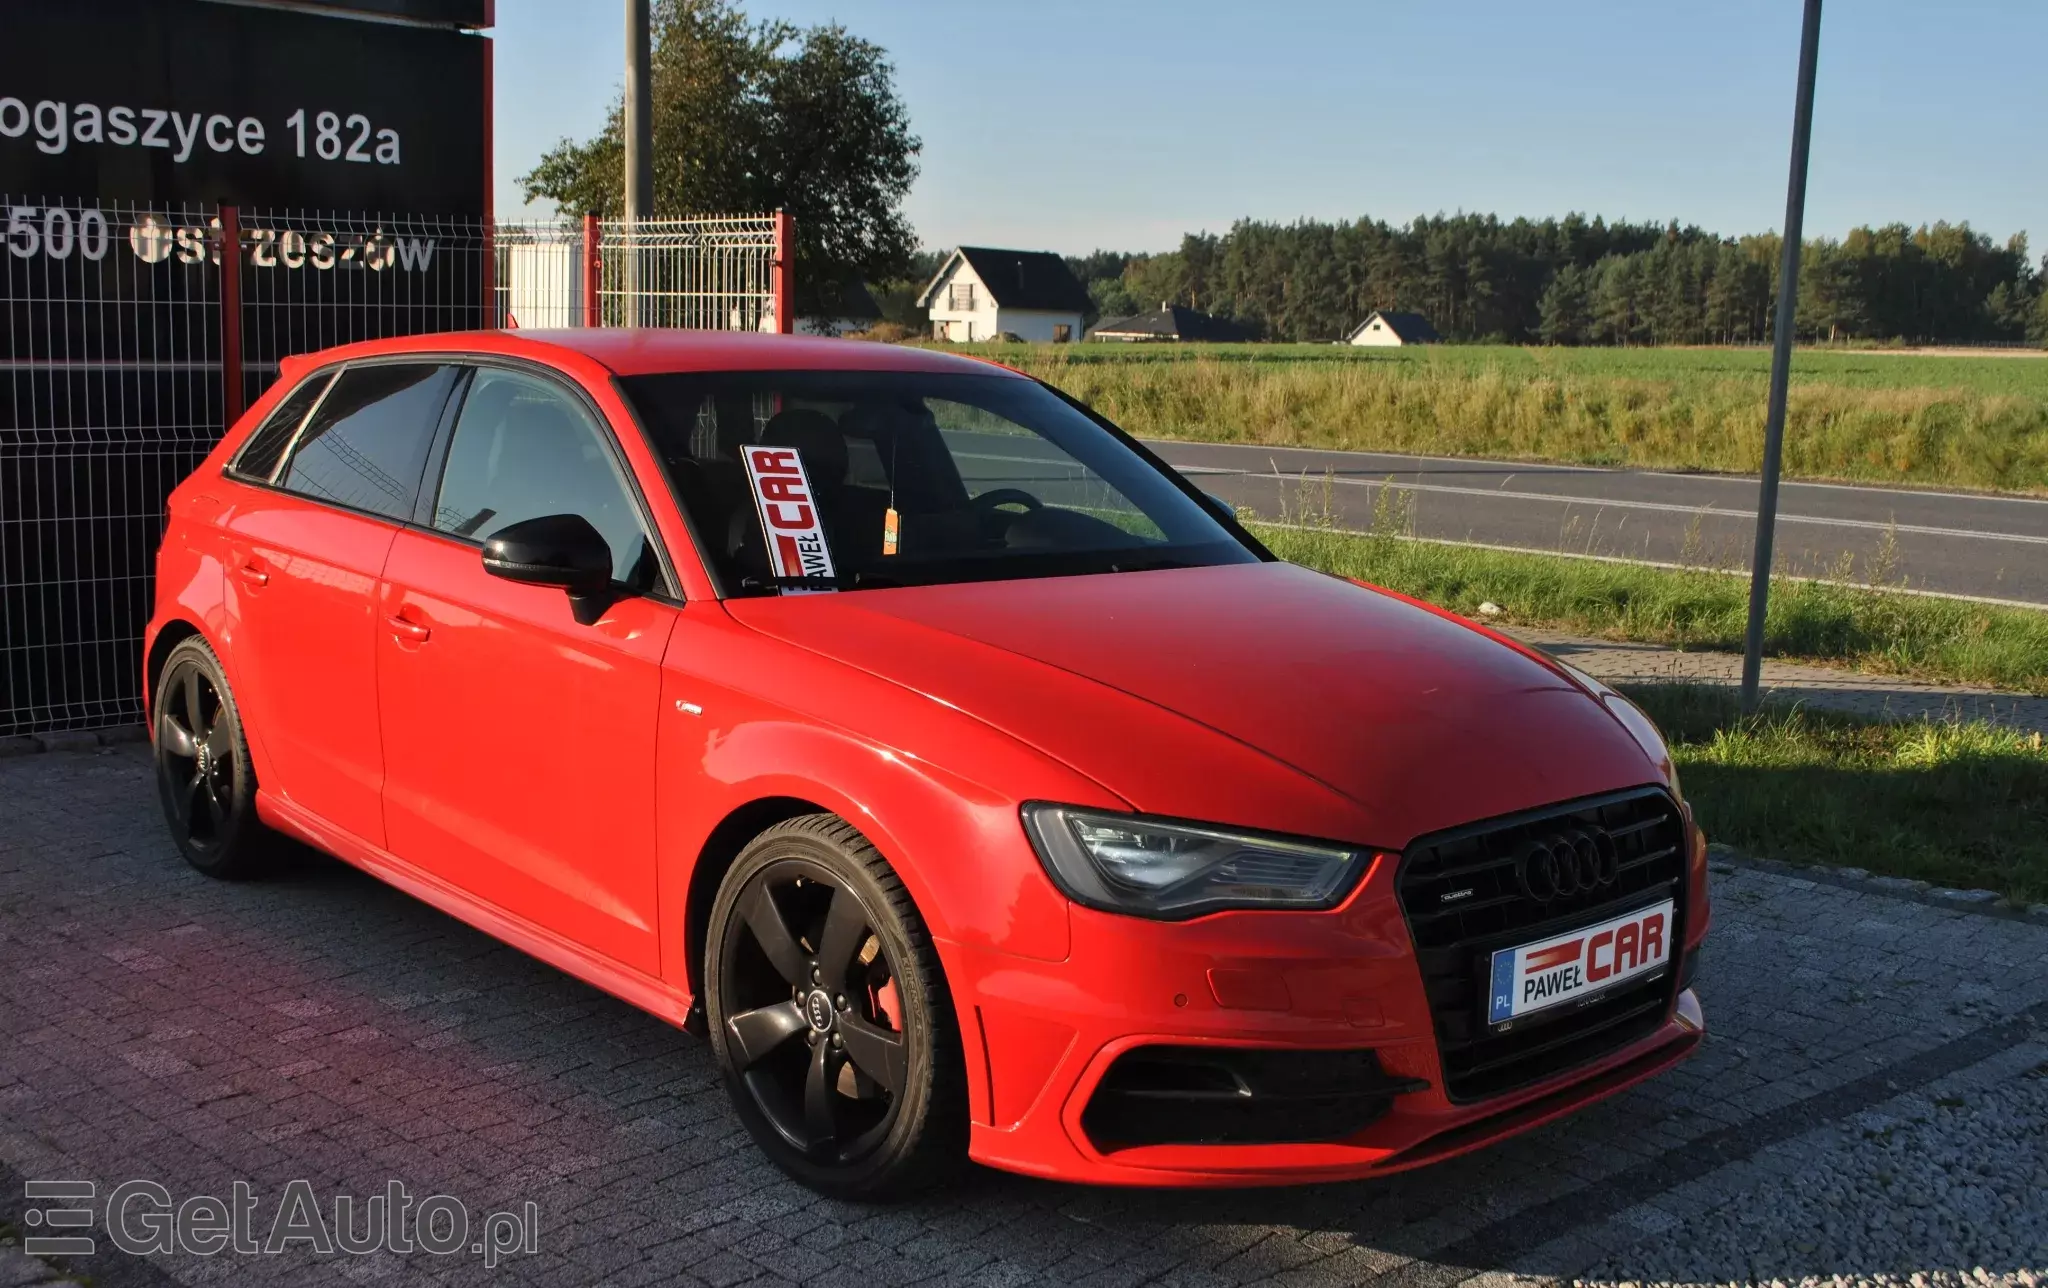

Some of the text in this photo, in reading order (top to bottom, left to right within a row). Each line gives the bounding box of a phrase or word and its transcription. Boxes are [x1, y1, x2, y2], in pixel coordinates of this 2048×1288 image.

[286, 108, 401, 164] 182a
[130, 212, 435, 272] Ostzeszów
[752, 450, 815, 530] CAR
[1586, 912, 1664, 983] CAR
[1495, 994, 1510, 1010] PL
[1524, 965, 1583, 1004] PAWEŁ
